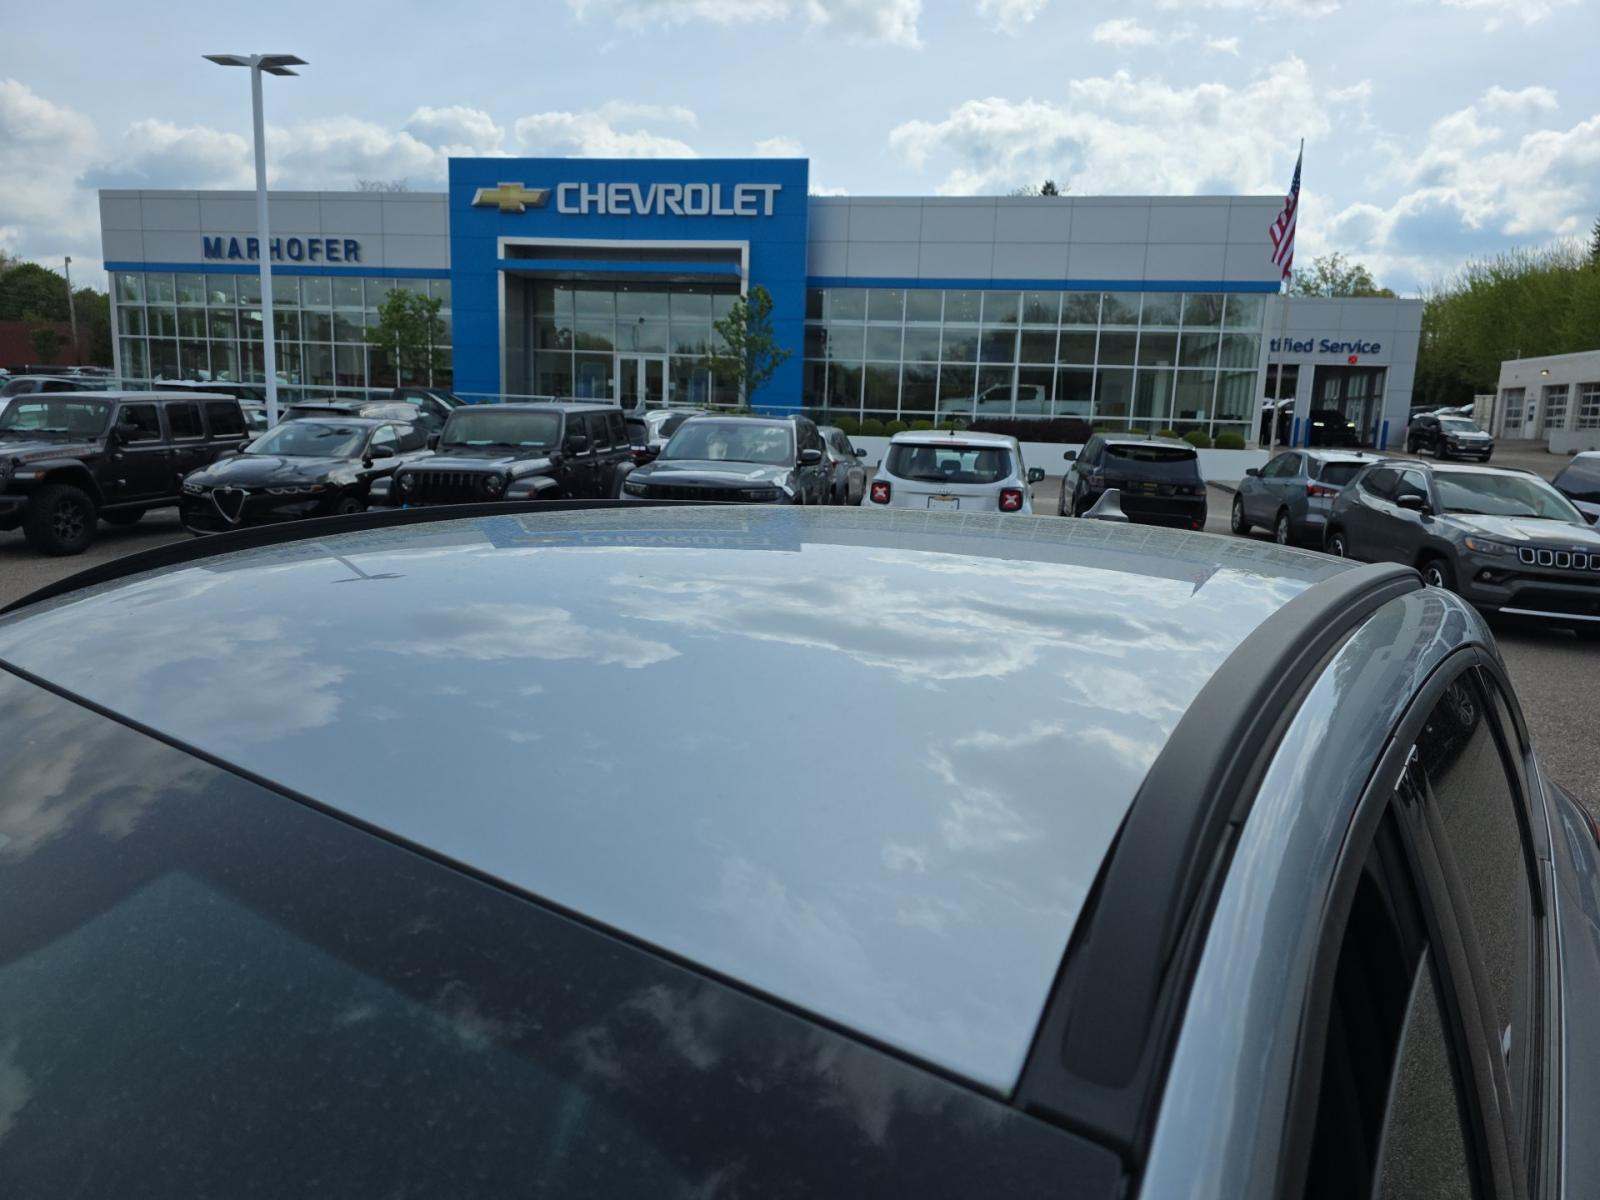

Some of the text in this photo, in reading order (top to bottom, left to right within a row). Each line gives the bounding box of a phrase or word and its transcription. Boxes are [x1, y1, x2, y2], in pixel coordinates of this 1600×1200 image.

[556, 182, 782, 216] CHEVROLET
[203, 236, 361, 262] MARHOFER
[1319, 338, 1381, 354] Service
